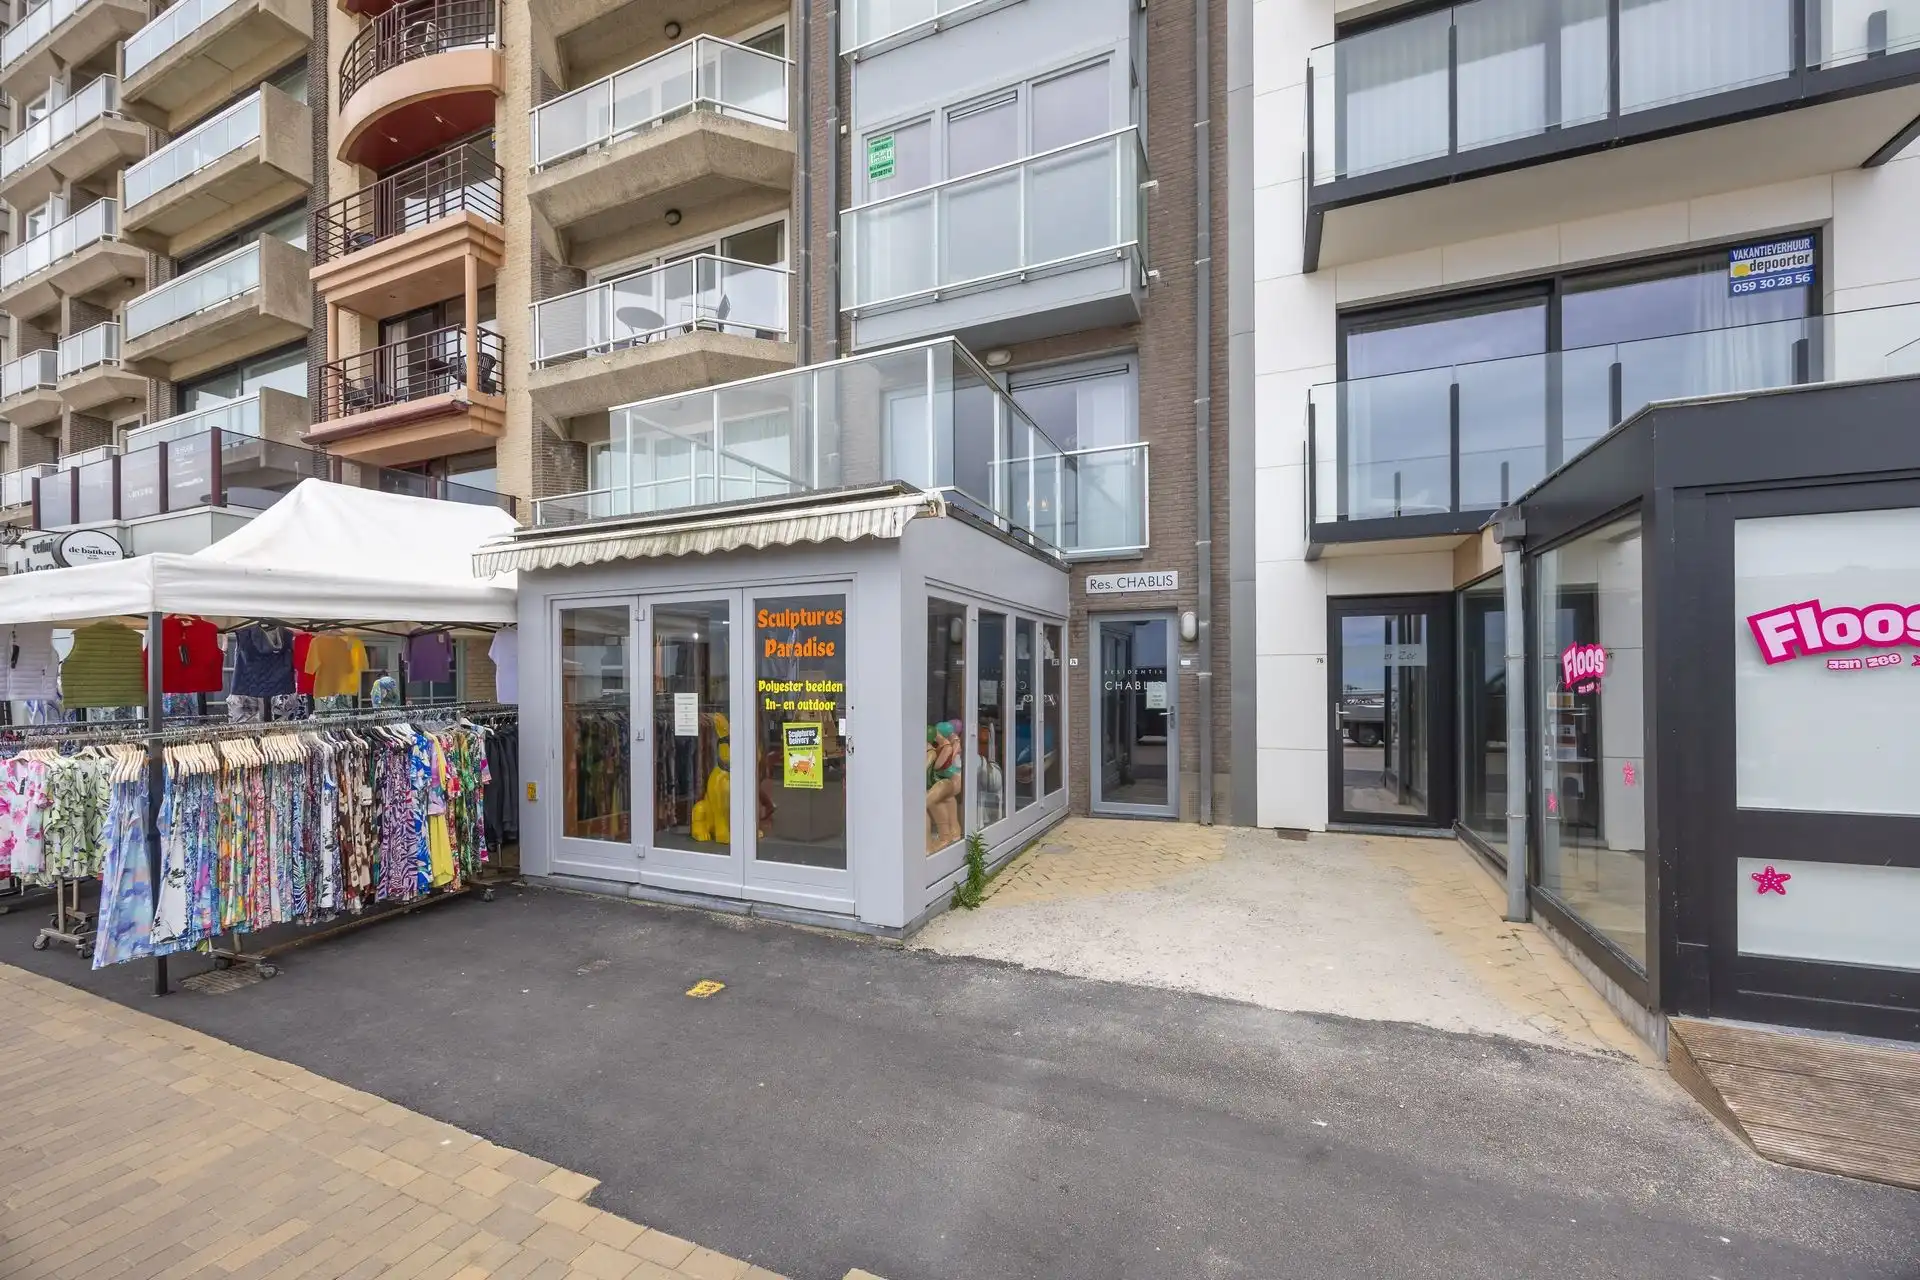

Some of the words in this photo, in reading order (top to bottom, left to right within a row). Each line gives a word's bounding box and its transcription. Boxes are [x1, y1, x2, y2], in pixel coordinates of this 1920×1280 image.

[1733, 239, 1810, 260] VAKANTIEVERHUUR
[1750, 254, 1810, 272] depoorter
[1733, 282, 1756, 293] 059
[1760, 279, 1775, 289] 30
[1778, 276, 1793, 286] 28
[1795, 273, 1811, 283] 56
[1090, 579, 1113, 590] Res.
[1117, 574, 1174, 589] CHABLIS
[757, 607, 844, 630] Sculptures
[764, 635, 836, 658] Paradise
[1562, 643, 1606, 686] Floos
[1828, 659, 1862, 670] aan
[1866, 653, 1901, 668] zee
[758, 680, 803, 693] Polyester
[805, 680, 844, 693] beelden
[765, 697, 781, 710] In-
[783, 700, 795, 710] en
[797, 698, 836, 711] outdoor
[788, 729, 816, 738] Sculptures
